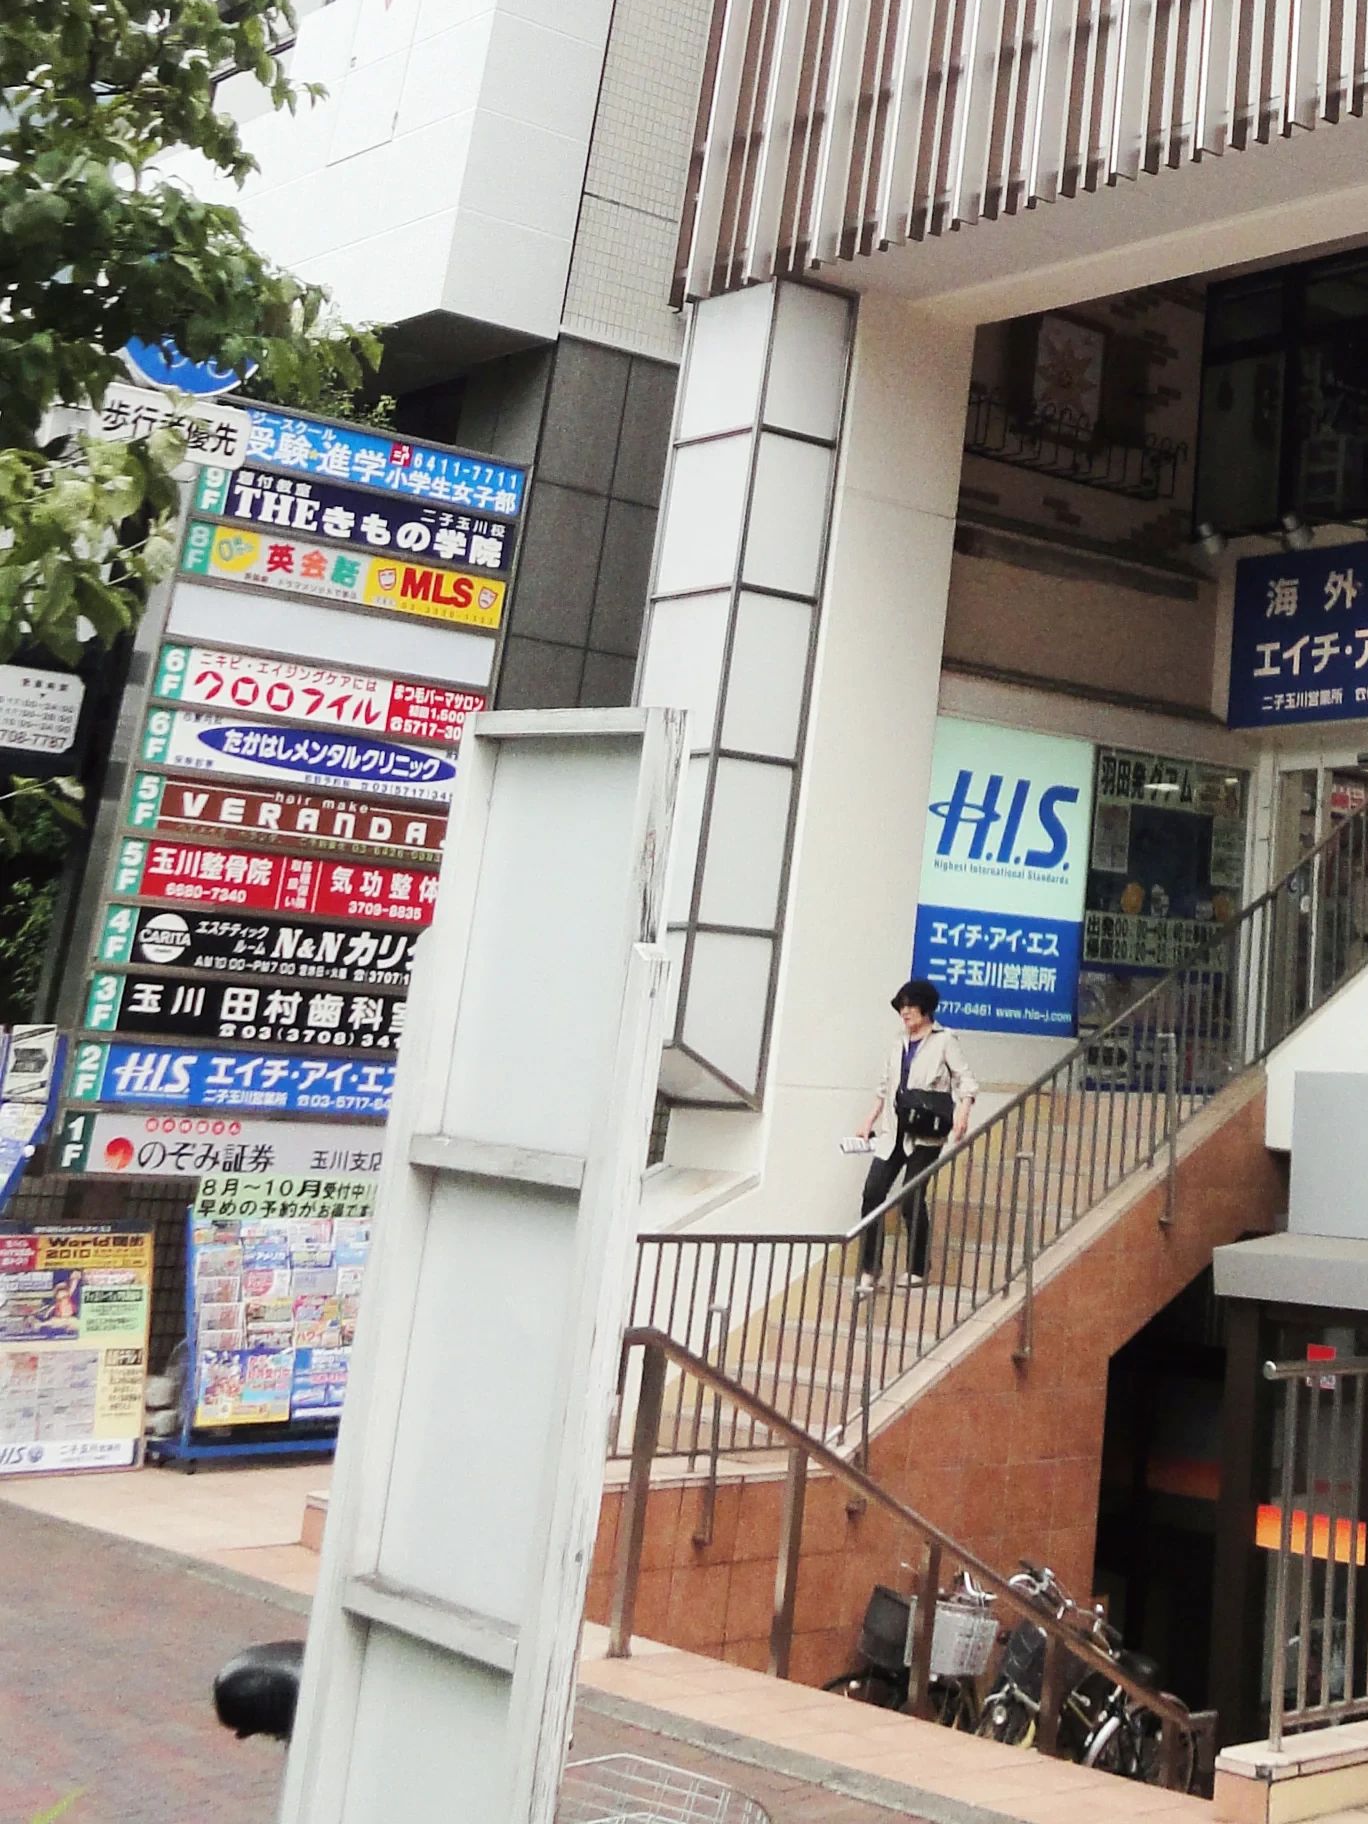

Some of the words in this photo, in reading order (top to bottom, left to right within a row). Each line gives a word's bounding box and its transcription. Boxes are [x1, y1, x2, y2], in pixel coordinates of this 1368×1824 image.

[386, 468, 517, 515] 小学生女子部
[414, 452, 518, 490] 6411-7711
[182, 524, 209, 570] 8F
[234, 484, 504, 569] THEきもの学院
[266, 543, 361, 589] 英会話
[400, 567, 474, 609] MLS
[162, 649, 186, 695] 6F
[1261, 687, 1344, 711] 二子玉川営業所
[146, 711, 170, 759] 6F
[222, 728, 441, 780] たかはしメンタルクリニック
[134, 776, 161, 825] 5F
[275, 790, 312, 806] hair
[322, 797, 369, 813] make
[116, 841, 144, 891] 5F
[148, 846, 273, 886] 玉川整骨院
[104, 908, 132, 958] 4F
[139, 928, 192, 947] CARITA
[930, 921, 1060, 957] エイチ・アイ・エス
[927, 957, 1057, 993] 二子玉川営業所
[91, 975, 117, 1027] 3F
[75, 1045, 103, 1097] 2F
[61, 1115, 85, 1168] 1F
[138, 1141, 276, 1173] のぞみ証券
